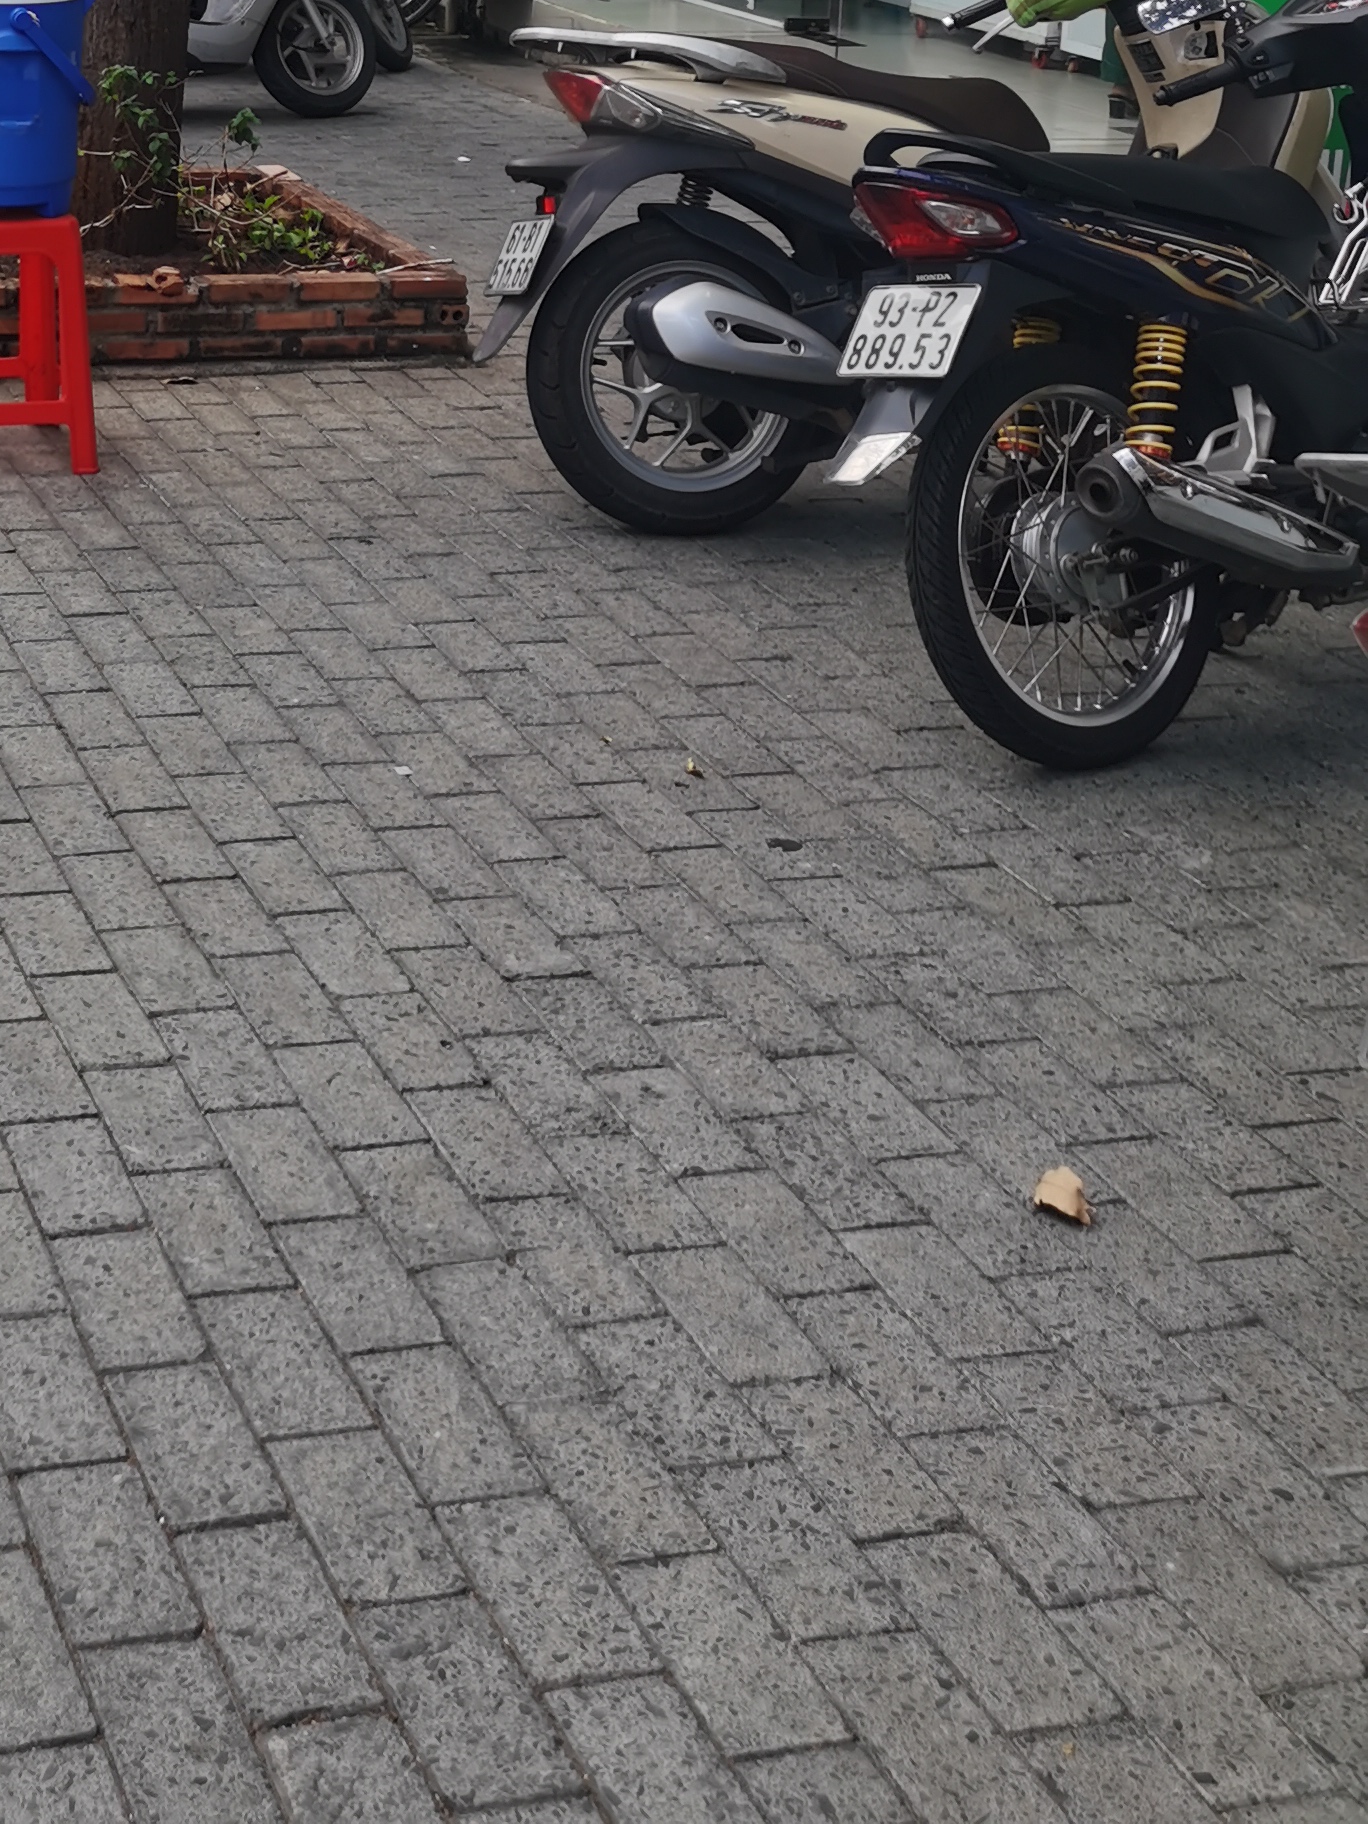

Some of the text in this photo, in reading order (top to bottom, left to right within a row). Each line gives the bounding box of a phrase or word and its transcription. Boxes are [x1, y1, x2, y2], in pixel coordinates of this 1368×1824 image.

[916, 272, 952, 282] HONDA
[873, 291, 958, 328] 93-P2
[846, 333, 952, 370] 889.53
